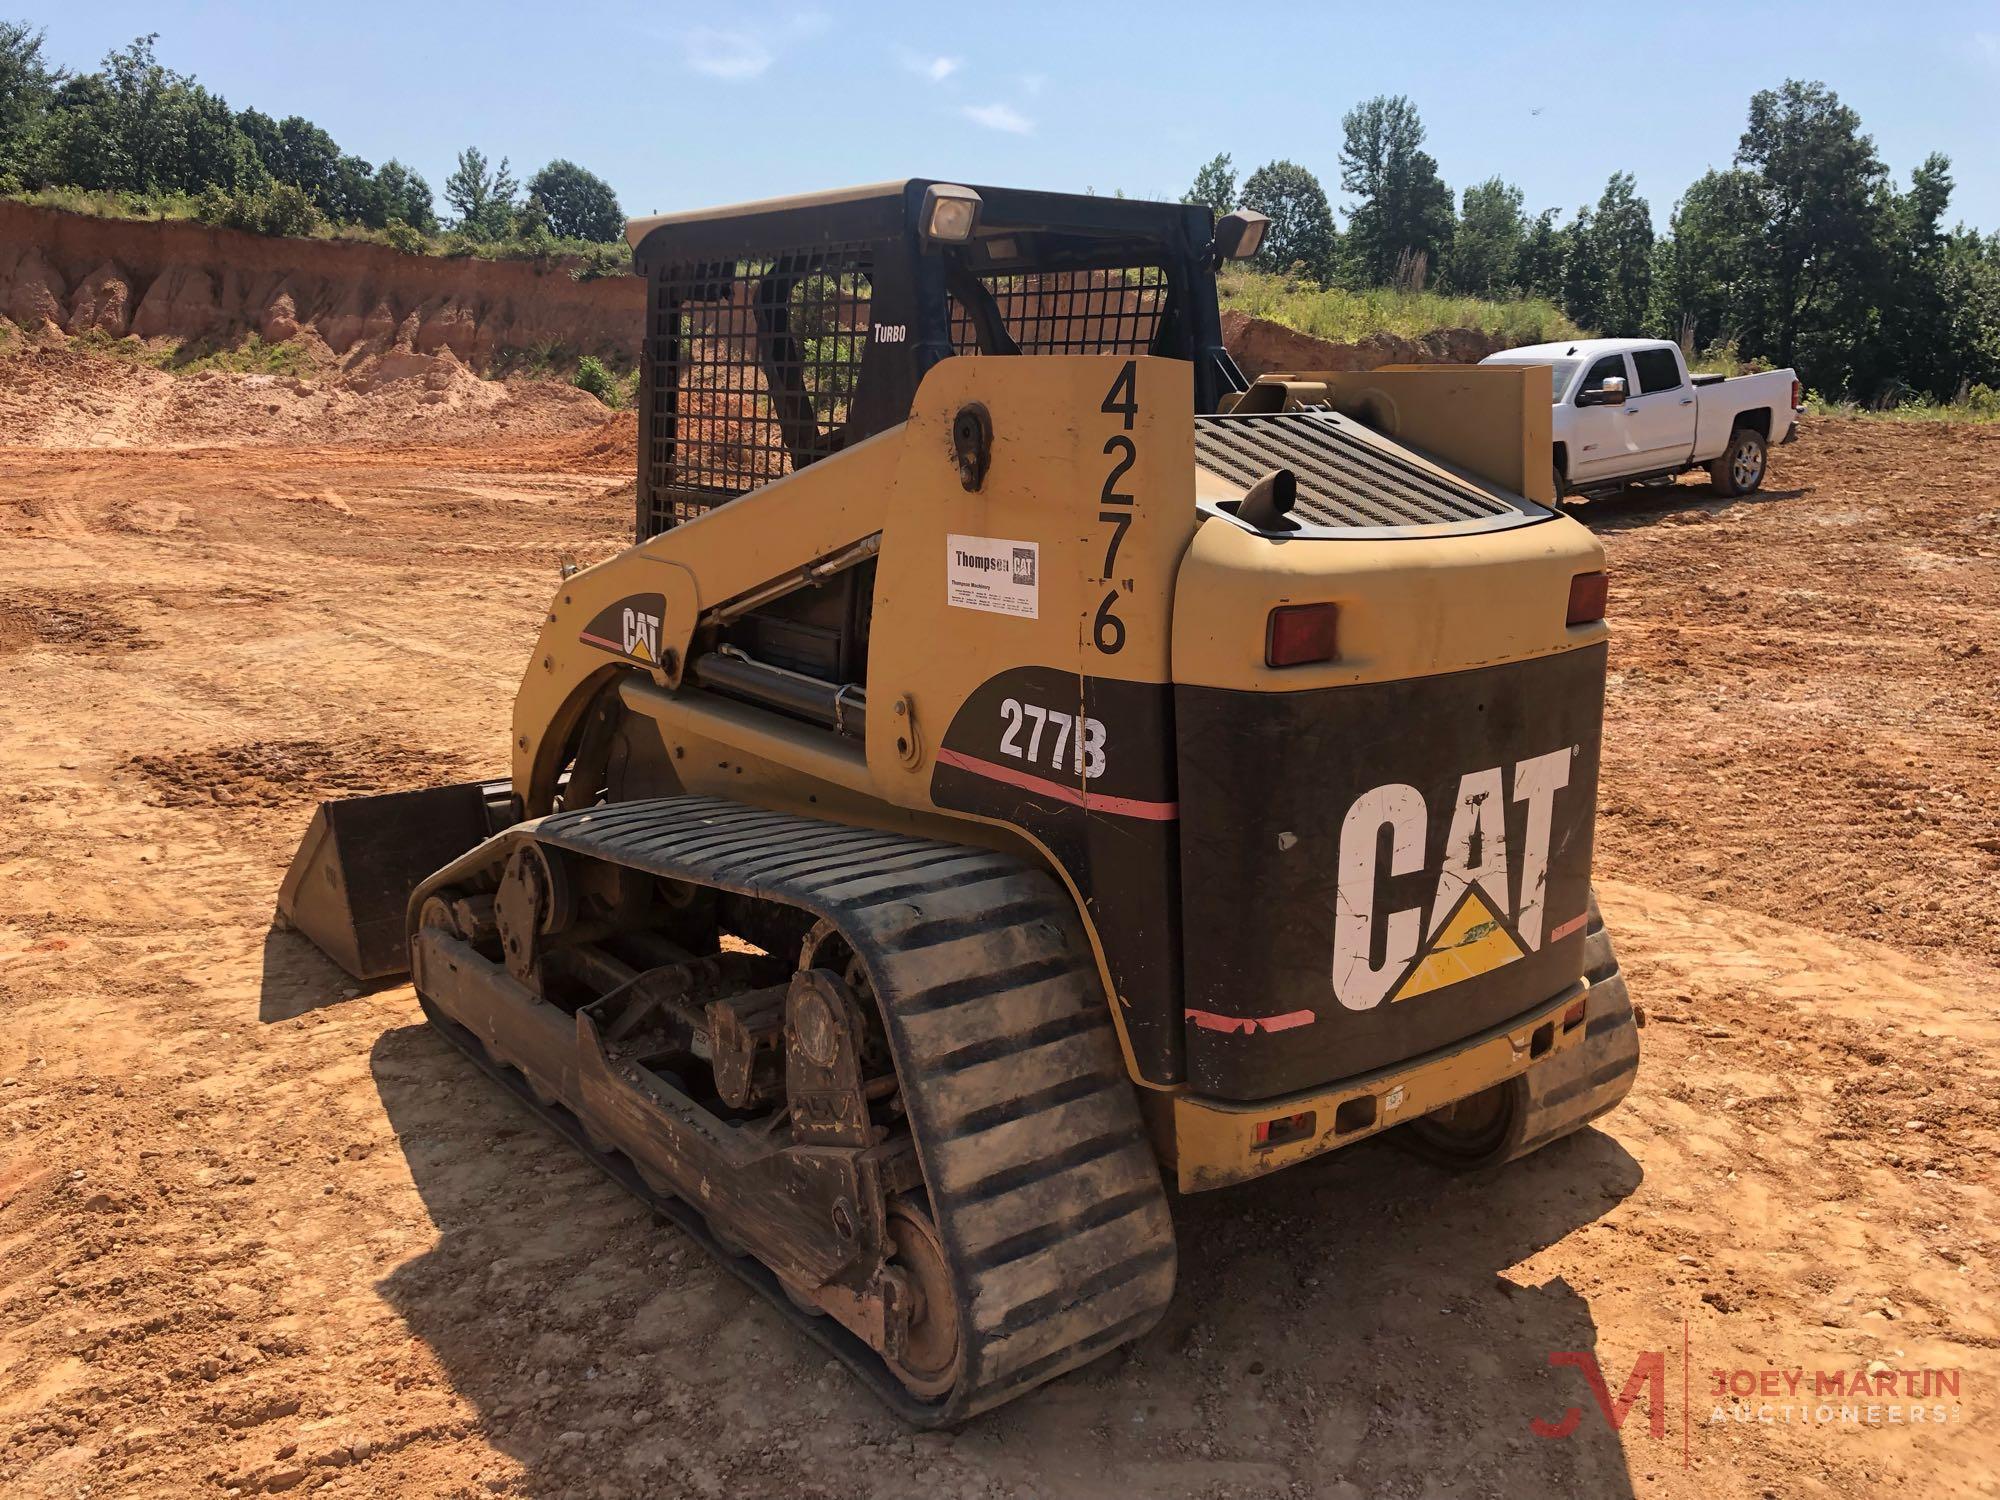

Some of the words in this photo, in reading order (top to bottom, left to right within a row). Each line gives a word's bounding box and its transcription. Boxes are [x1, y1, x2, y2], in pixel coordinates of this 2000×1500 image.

[874, 323, 906, 343] TURBO
[955, 551, 1009, 572] Thompson
[1014, 557, 1032, 576] CAT
[622, 607, 659, 664] CAT
[999, 698, 1107, 779] 277B
[1332, 746, 1572, 1011] CAT
